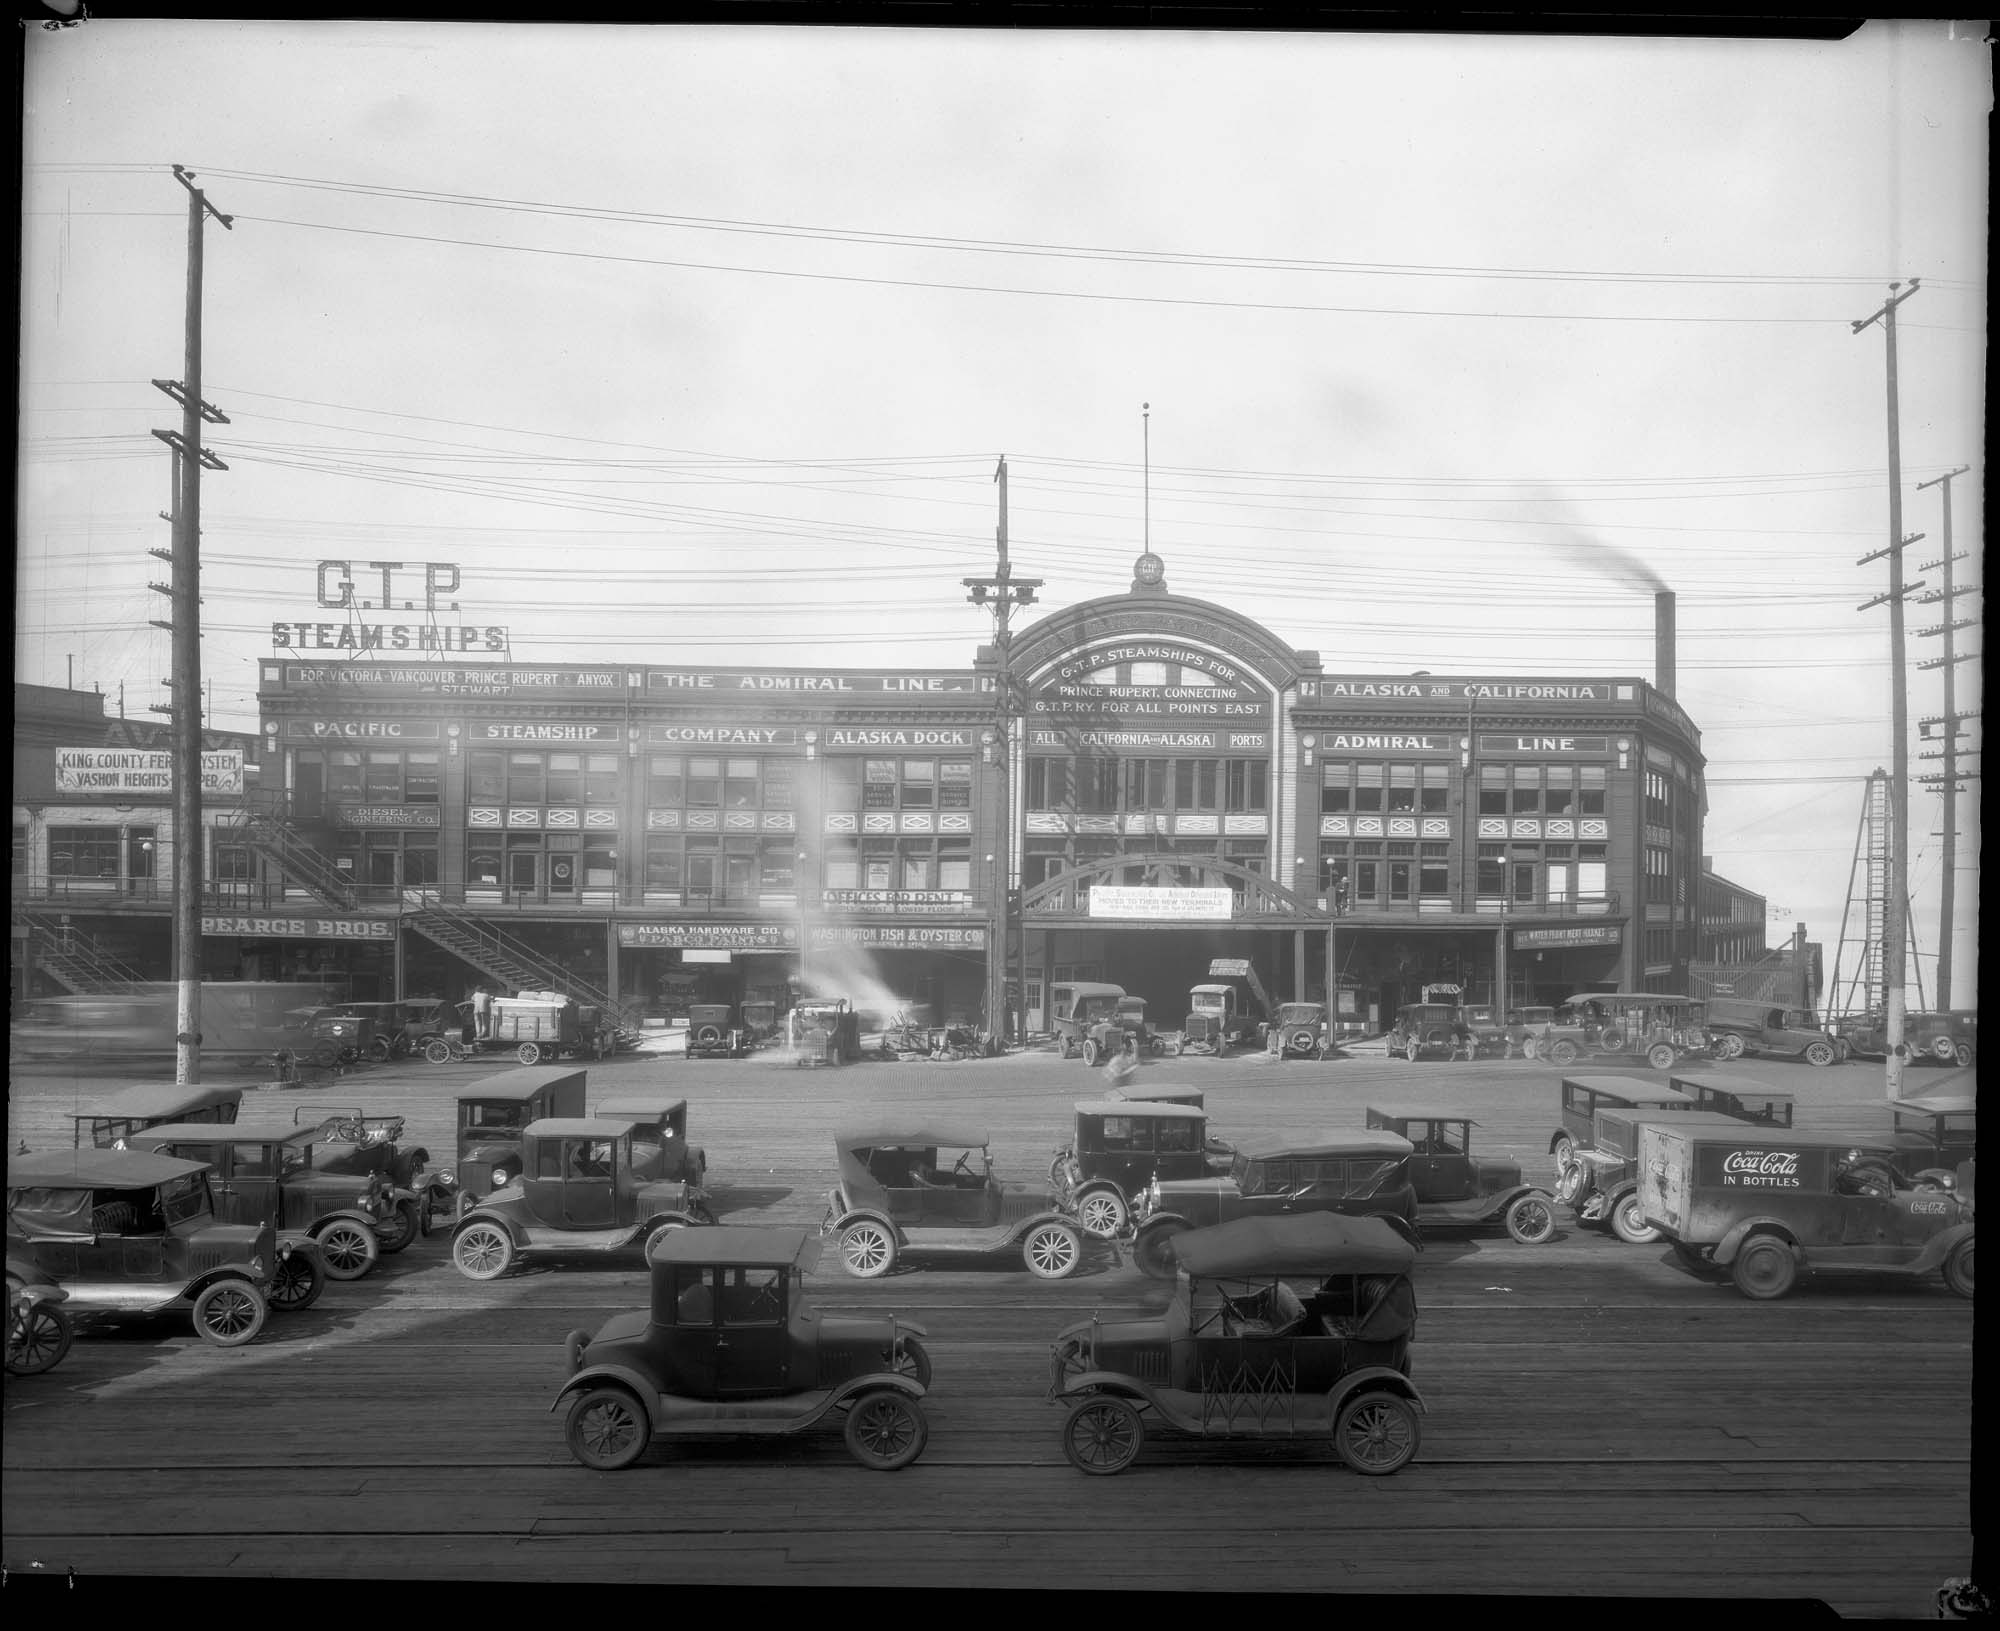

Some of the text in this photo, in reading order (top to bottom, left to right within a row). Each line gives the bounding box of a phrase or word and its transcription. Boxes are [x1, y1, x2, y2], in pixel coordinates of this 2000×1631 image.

[316, 560, 461, 610] G.T.P.
[271, 622, 503, 651] STEAMSHIPS
[1061, 655, 1105, 678] G.T.P.
[1107, 647, 1205, 666] STEAMSHIPS
[1208, 661, 1236, 681] FOR
[300, 669, 614, 686] FOR VICTORIA VANCOUVER PRINCE RUPERT ANYOX
[663, 675, 945, 691] THE ADMIRAL LINE
[440, 684, 511, 697] STEWART
[1060, 687, 1103, 697] PRINCE
[1164, 688, 1237, 699] CONNECTING
[1333, 683, 1595, 699] ALASKA AND CALIFORNIA
[1101, 703, 1129, 713] FOR
[1135, 703, 1162, 713] ALL
[1169, 704, 1217, 714] POINTS
[1224, 704, 1262, 714] EAST
[313, 721, 401, 737] PACIFIC
[486, 724, 599, 740] STEAMSHIP
[665, 728, 777, 743] COMPANY
[832, 731, 964, 745] ALASKA DOCK
[1035, 732, 1057, 744] ALL
[1081, 733, 1151, 746] CALIFORNIA
[1160, 734, 1211, 746] ALASKA
[1231, 735, 1263, 746] PORTS
[1334, 735, 1434, 749] ADMIRAL
[1517, 737, 1575, 751] LINE
[62, 753, 93, 769] KING
[97, 754, 145, 769] COUNTY
[76, 772, 119, 787] VASHON
[358, 808, 408, 816] DIESEL
[827, 891, 954, 905] OFFICES FOR RENT
[315, 920, 394, 937] BROS.
[638, 926, 780, 935] ALASKA HARDWARE CO.
[880, 928, 904, 941] FISH
[908, 929, 918, 941] &
[920, 929, 962, 942] OYSTER
[1723, 1175, 1800, 1187] IN BOTTLES
